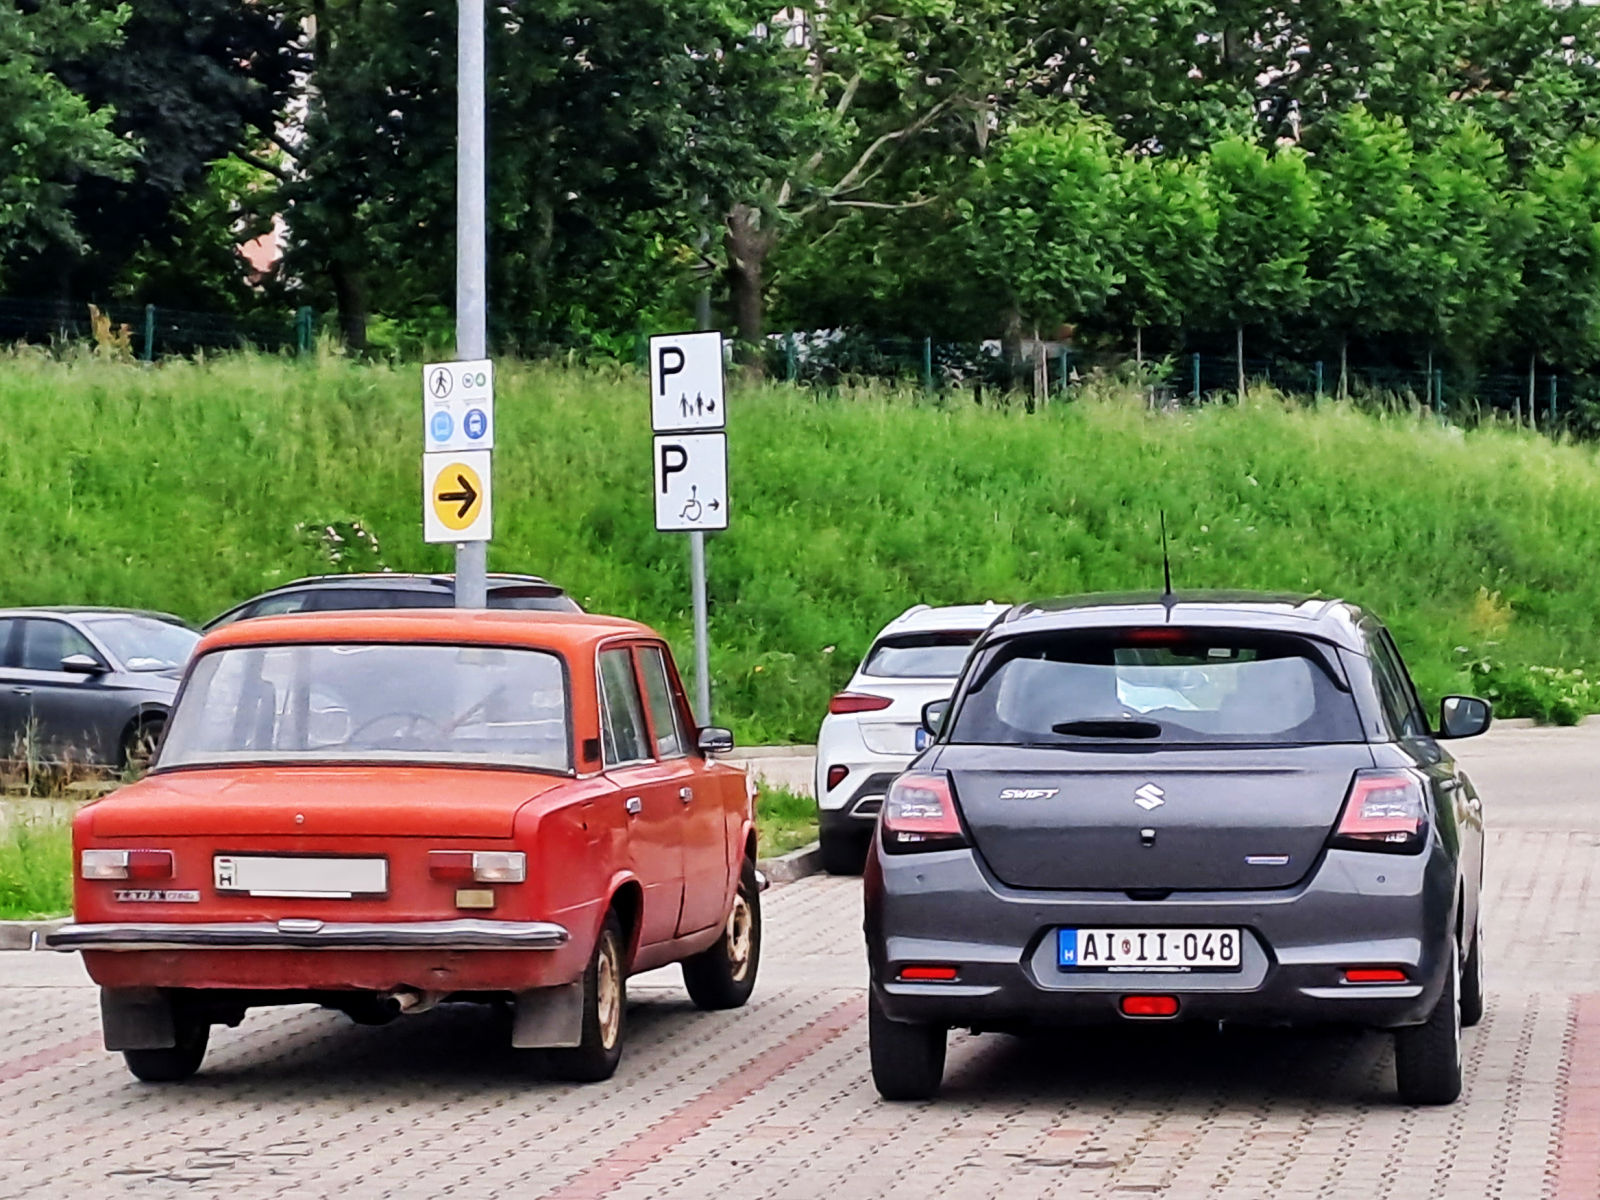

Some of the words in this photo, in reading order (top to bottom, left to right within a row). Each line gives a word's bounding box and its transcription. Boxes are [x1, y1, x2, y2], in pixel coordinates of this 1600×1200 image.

[659, 346, 685, 396] P
[661, 444, 688, 494] P
[1000, 788, 1060, 800] SWIFT
